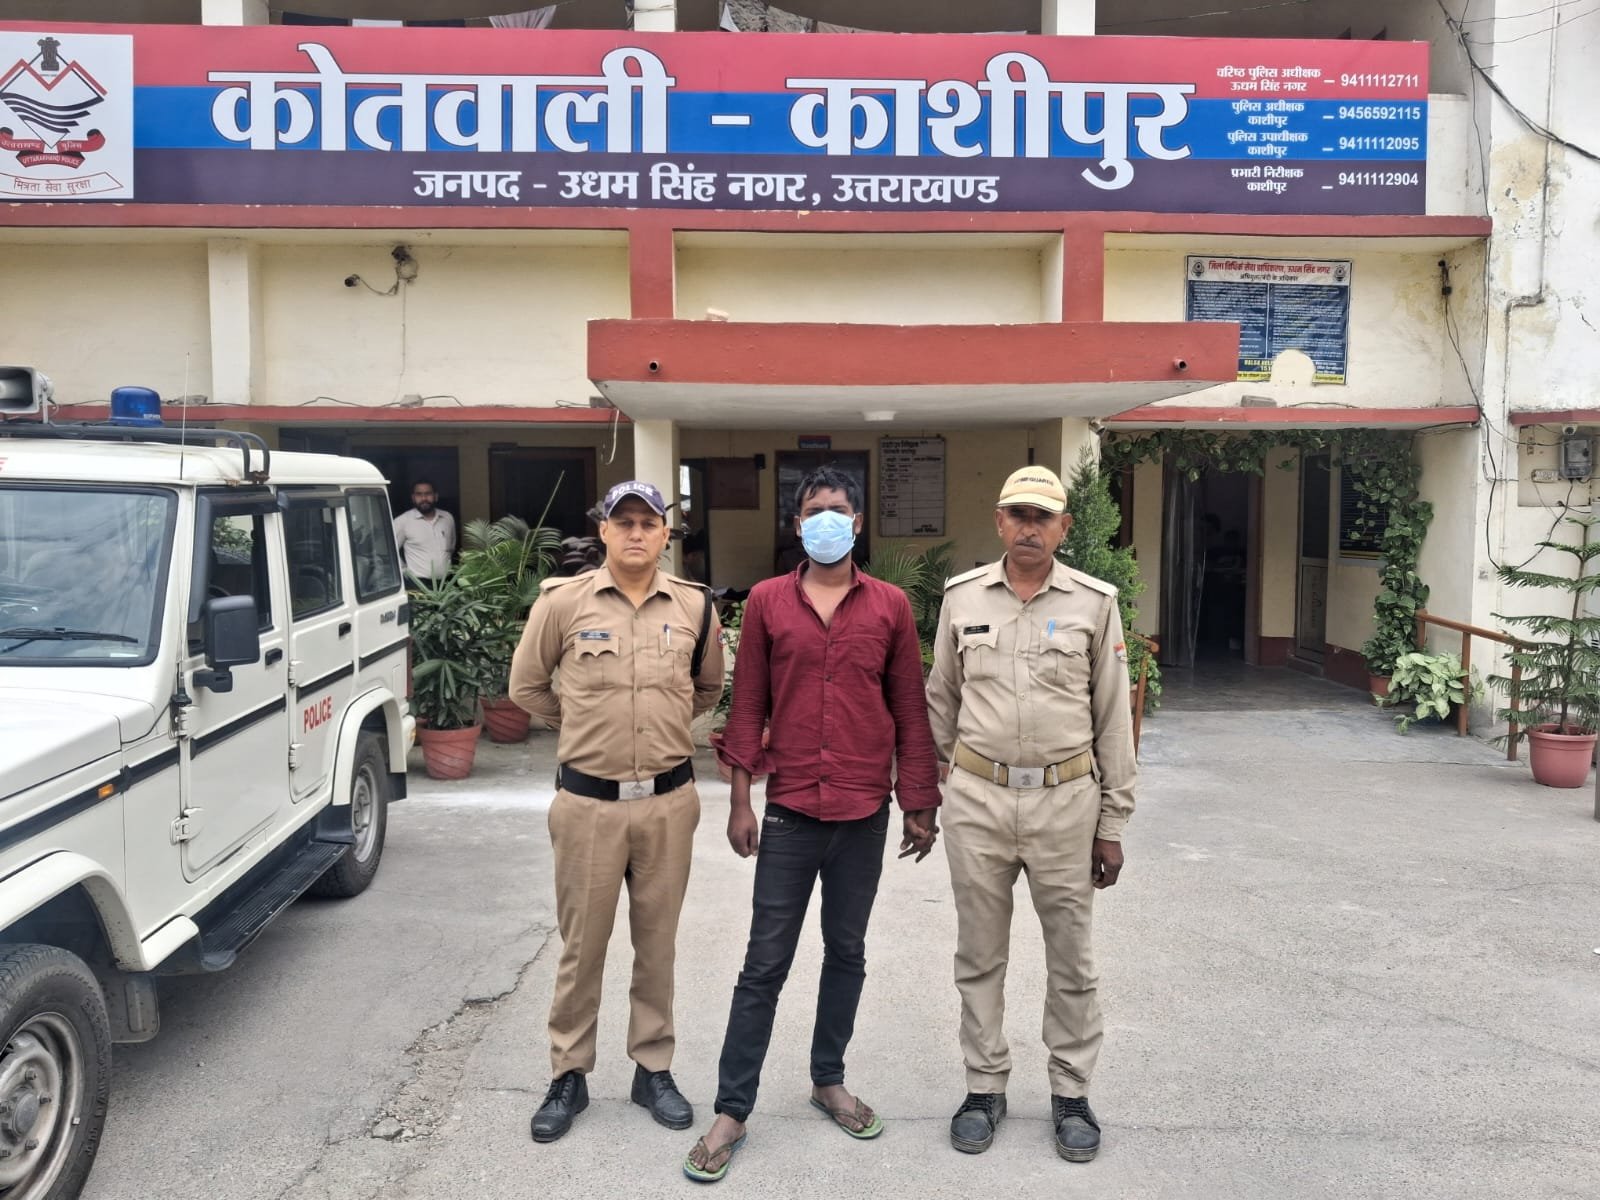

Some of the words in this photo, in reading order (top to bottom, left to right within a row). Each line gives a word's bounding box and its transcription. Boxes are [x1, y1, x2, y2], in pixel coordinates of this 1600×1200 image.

[1217, 65, 1246, 78] वरिष्ठ
[1249, 65, 1278, 78] पुलिस
[1282, 65, 1321, 78] अधीक्षक
[1260, 79, 1281, 91] सिंह
[1283, 81, 1307, 92] नगर
[1340, 74, 1419, 87] 9411112711
[1231, 99, 1261, 112] पुलिस
[1265, 99, 1304, 112] अधीक्षक
[1339, 106, 1420, 119] 9456592115
[208, 43, 676, 153] कोतवाली
[785, 51, 1196, 190] काशीपुर
[1248, 113, 1288, 128] काशीपुर
[1227, 130, 1257, 144] पुलिस
[1260, 130, 1308, 143] उपाधीक्षक
[1339, 137, 1419, 150] 9411112095
[1247, 144, 1288, 158] काशीपुर
[1231, 165, 1261, 178] प्रभारी
[1264, 165, 1304, 178] निरीक्षक
[14, 177, 41, 192] मित्रता
[45, 180, 62, 193] सेवा
[66, 179, 92, 195] सुरक्षा
[413, 170, 523, 201] जनपद
[558, 172, 640, 200] उधम
[649, 162, 717, 200] सिंह
[726, 173, 820, 205] नगर,
[831, 174, 1001, 203] उत्तराखण्ड
[1338, 173, 1419, 186] 9411112904
[1247, 180, 1287, 194] काशीपुर
[612, 483, 653, 499] POLICE
[304, 696, 332, 734] POLICE
